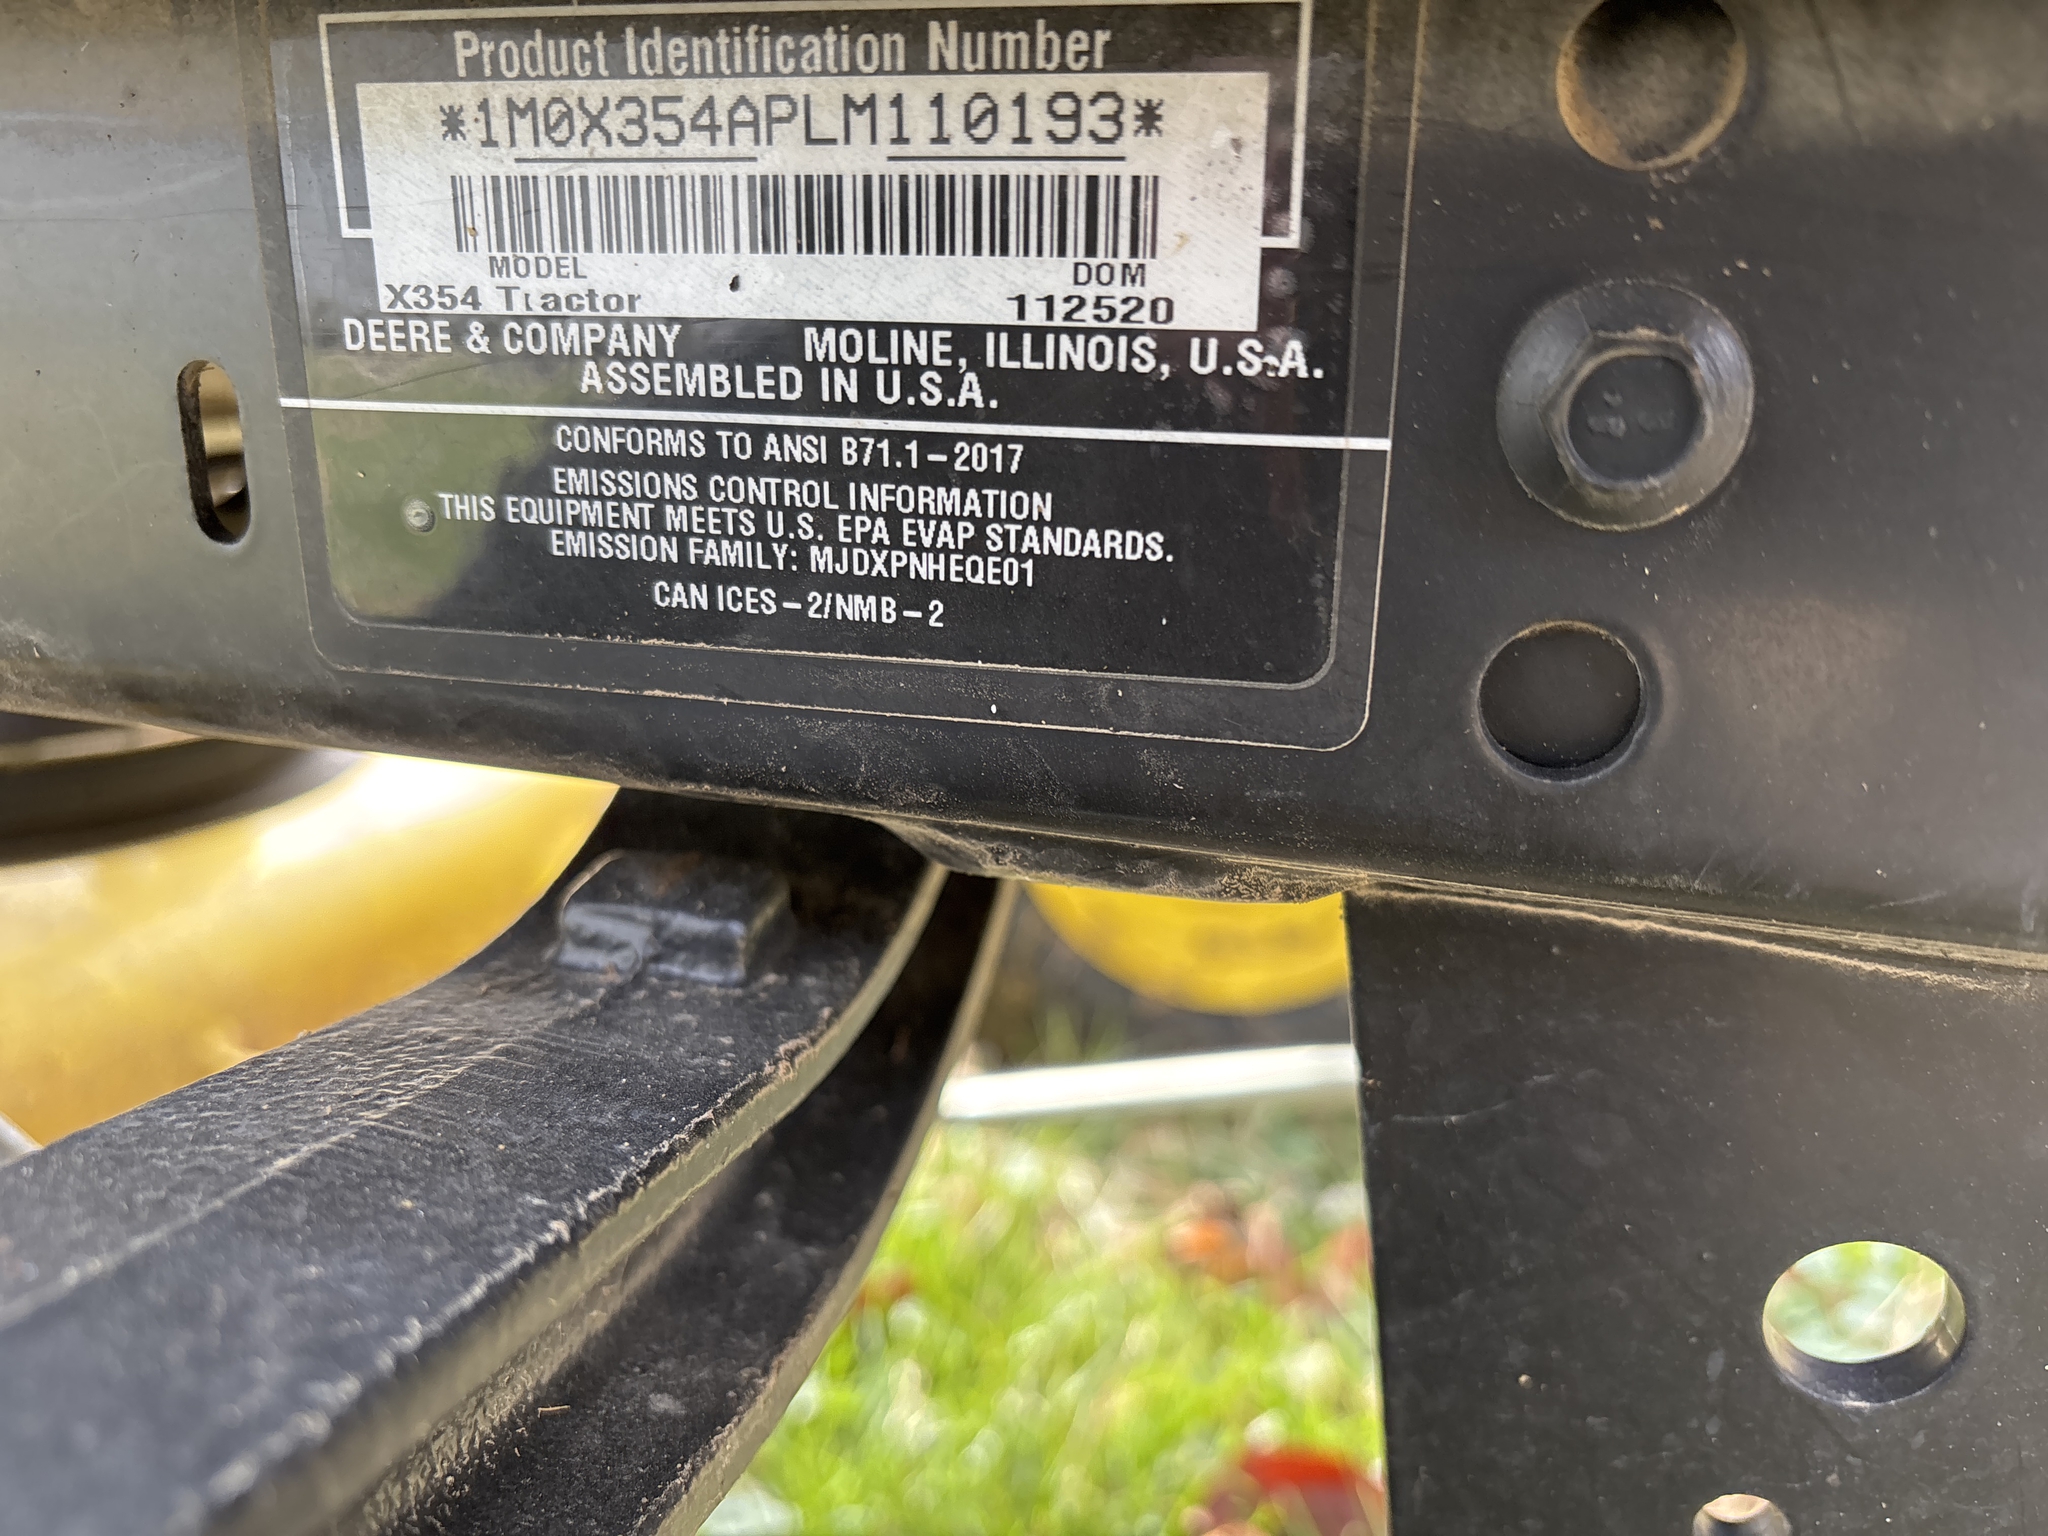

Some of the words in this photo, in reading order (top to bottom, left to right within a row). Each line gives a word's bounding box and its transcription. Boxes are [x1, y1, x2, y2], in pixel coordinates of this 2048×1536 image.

[454, 28, 610, 78] Product
[625, 25, 906, 77] Identification
[928, 19, 1112, 72] Number
[489, 256, 587, 280] MODEL
[1073, 262, 1146, 287] DOM
[384, 284, 482, 311] X354
[1007, 294, 1174, 325] 112520
[343, 318, 452, 354] DEERE
[466, 321, 493, 355] &
[503, 321, 682, 359] COMPANY
[804, 327, 967, 374] MOLINE,
[985, 332, 1170, 381] ILLINOIS,
[1189, 337, 1325, 379] U.S.A.
[579, 360, 802, 401] ASSEMBLED
[821, 367, 858, 403] IN
[875, 368, 999, 409] U.S.A.
[556, 425, 706, 459] CONFORMS
[715, 430, 753, 460] TO
[763, 433, 827, 464] ANSI
[553, 467, 698, 501] EMISSIONS
[709, 475, 839, 510] CONTROL
[849, 482, 1053, 522] INFORMATION
[438, 493, 495, 522] THIS
[506, 496, 655, 531] EQUIPMENT
[666, 504, 756, 537] MEETS
[767, 511, 824, 541] U.S.
[838, 514, 890, 545] EPA
[902, 518, 975, 550] EVAP
[985, 523, 1174, 562] STANDARDS.
[551, 529, 678, 563] EMISSION
[689, 538, 798, 572] FAMILY:
[810, 546, 1034, 587] MJDXPNHEQE01
[653, 581, 708, 611] CAN
